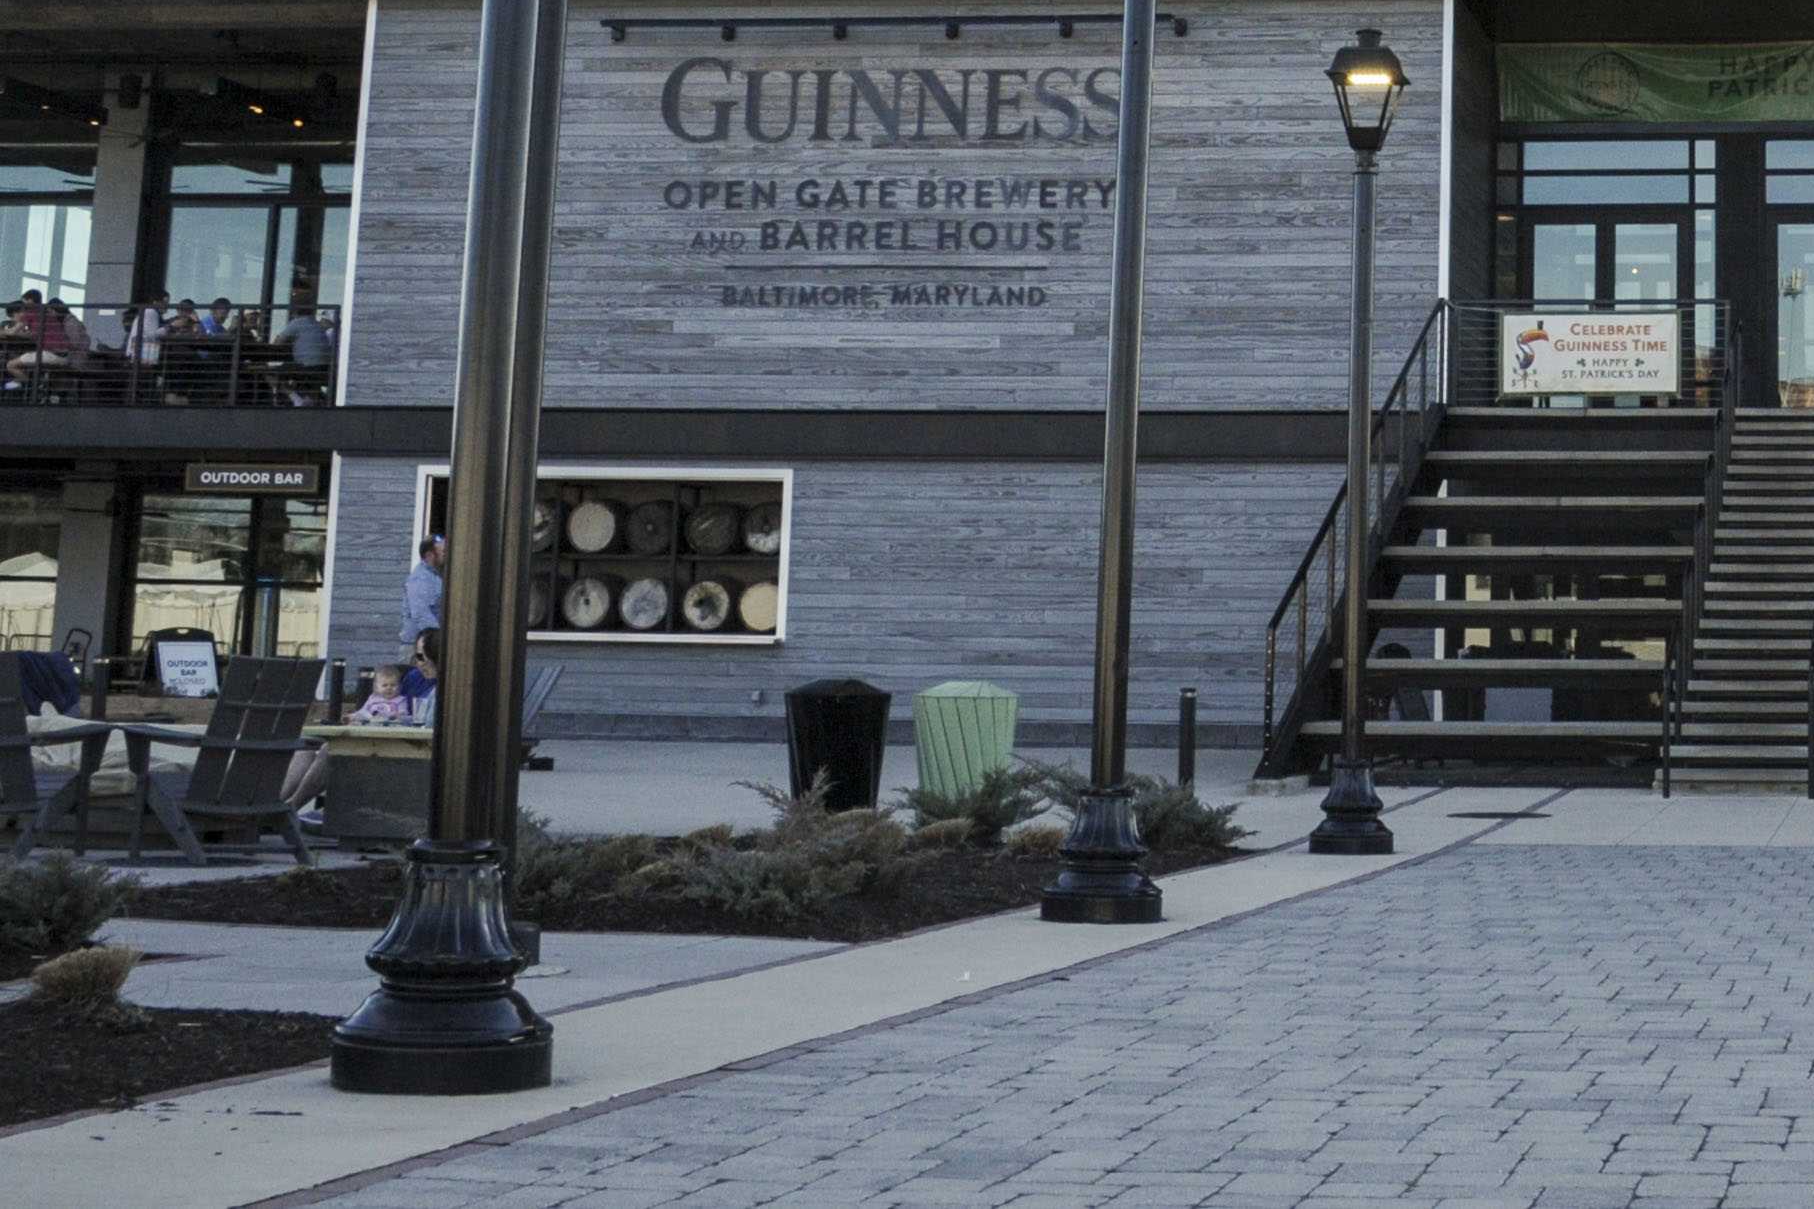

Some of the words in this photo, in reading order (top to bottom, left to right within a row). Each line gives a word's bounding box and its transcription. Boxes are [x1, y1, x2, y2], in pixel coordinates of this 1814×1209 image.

[1719, 52, 1814, 75] HAPPY
[661, 57, 1121, 144] GUINNESS
[663, 179, 777, 211] OPEN
[794, 179, 908, 210] GATE
[916, 177, 1116, 210] BREWERY
[691, 229, 744, 252] AND
[759, 219, 917, 252] BARREL
[937, 220, 1083, 252] HOUSE
[720, 286, 879, 309] BALTIMORE,
[890, 286, 1047, 307] MARYLAND
[1570, 323, 1651, 336] CELEBRATE
[1554, 339, 1627, 352] GUINNESS
[1632, 340, 1667, 352] TIME
[1592, 358, 1629, 367] HAPPY
[1561, 370, 1577, 379] ST.
[1580, 370, 1634, 379] PATRICK'S
[1638, 370, 1660, 378] DAY
[200, 472, 270, 484] OUTDOOR
[274, 473, 304, 484] BAR
[167, 660, 208, 668] OUTDOOR
